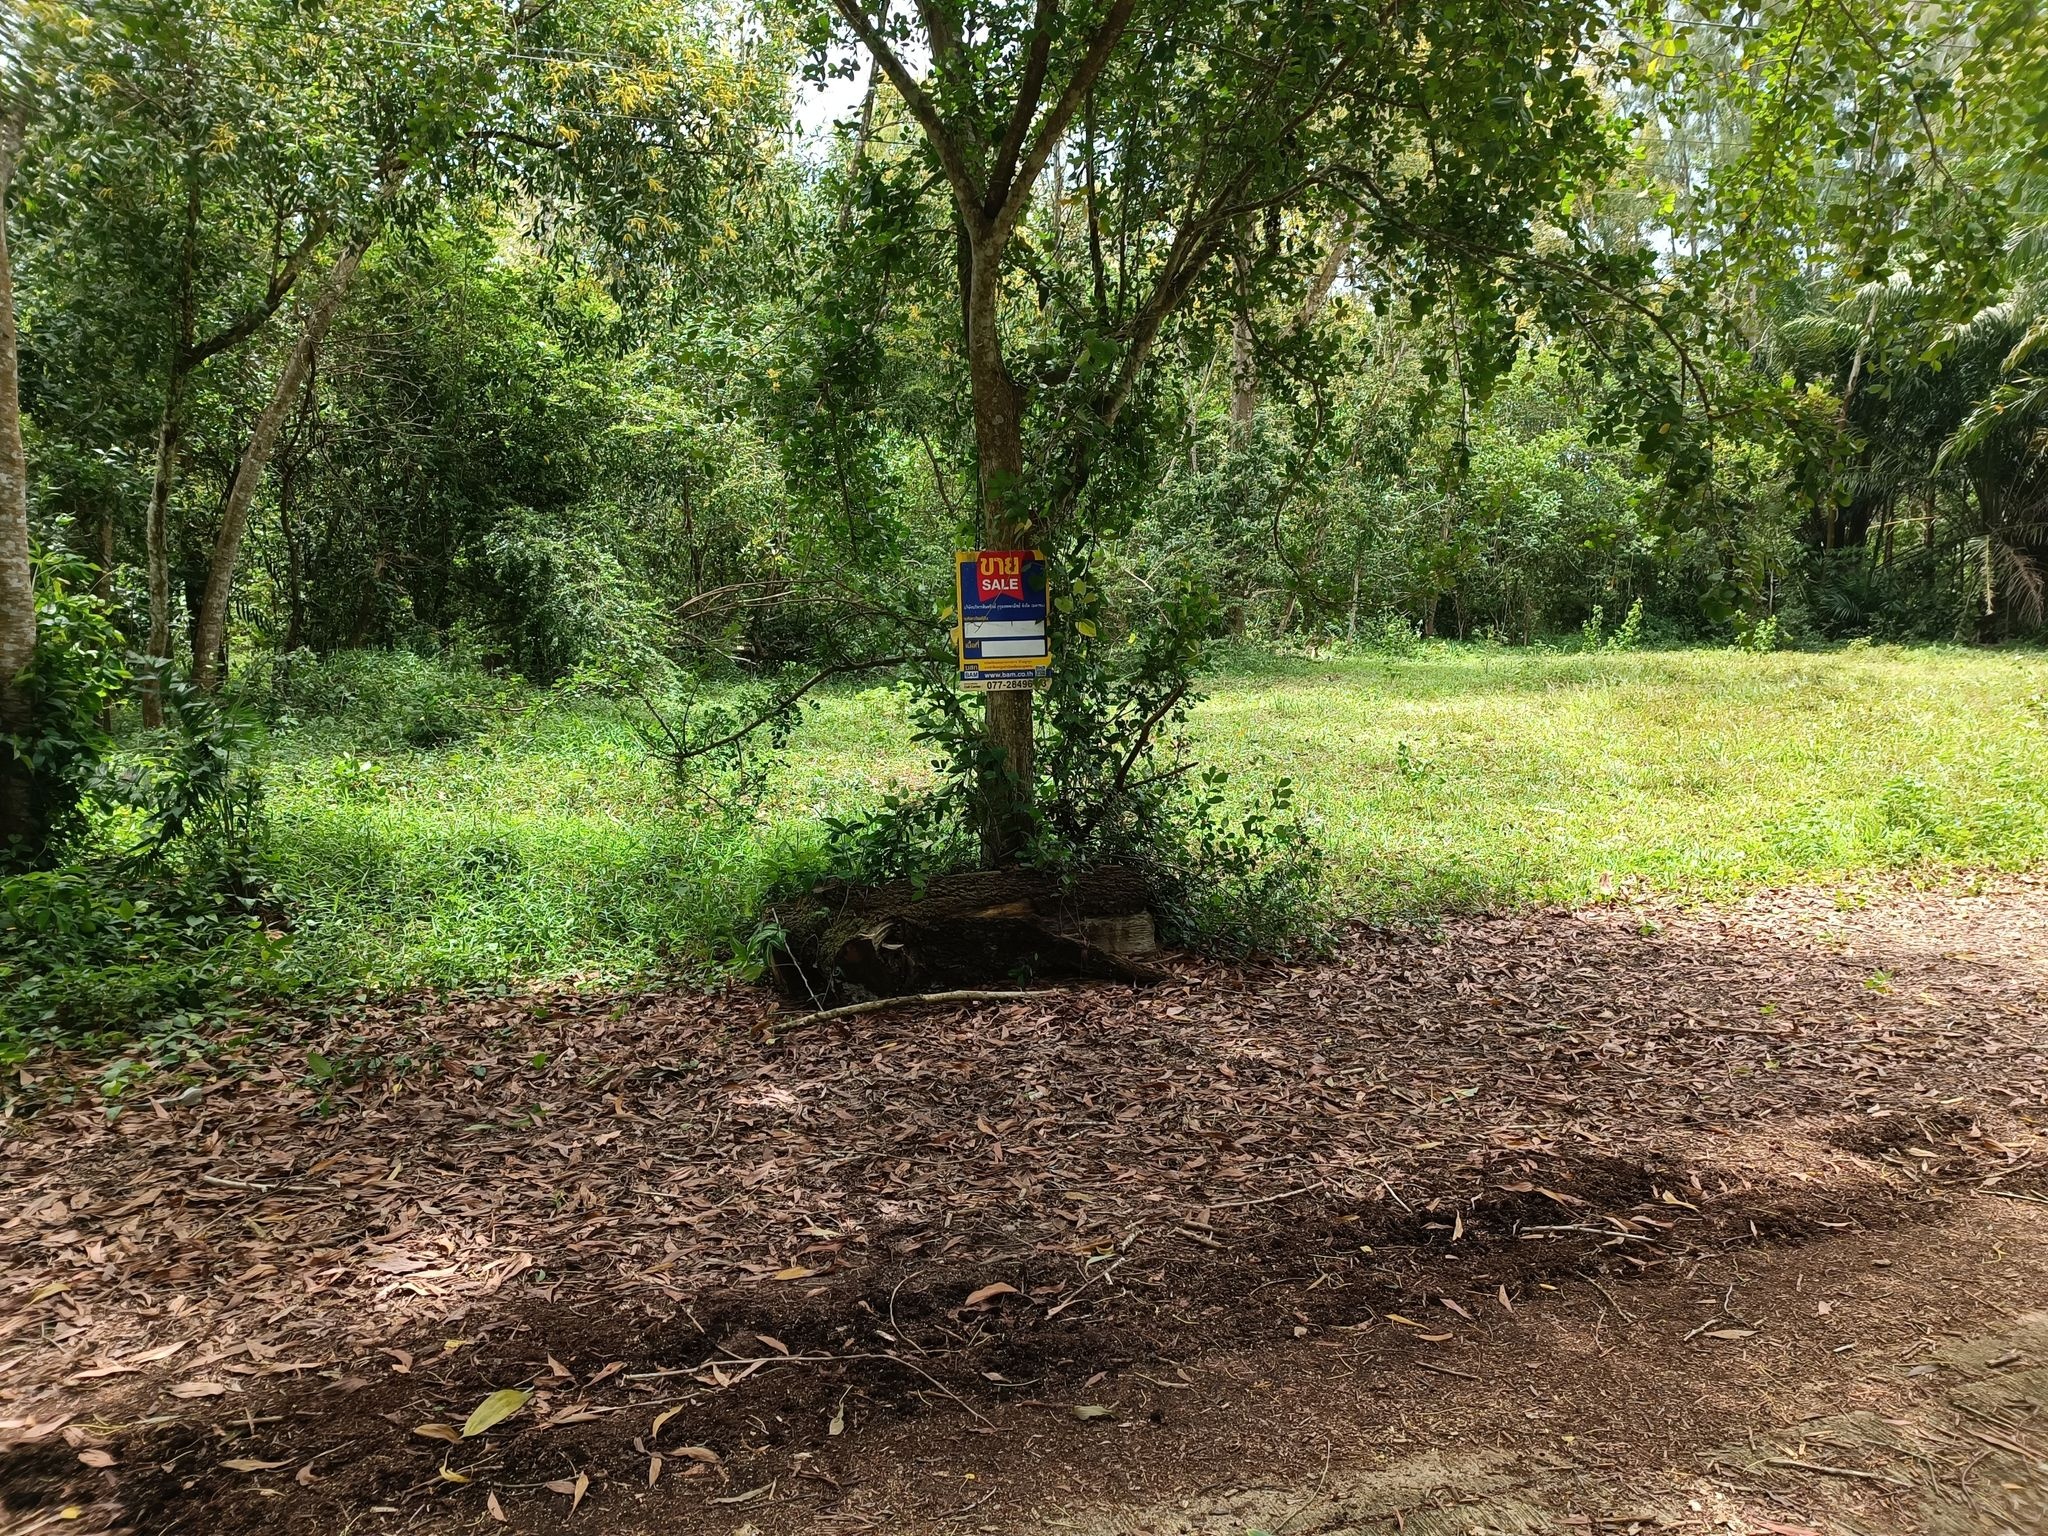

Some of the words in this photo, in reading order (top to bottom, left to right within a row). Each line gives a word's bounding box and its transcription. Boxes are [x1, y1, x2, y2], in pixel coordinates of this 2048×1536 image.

[980, 557, 1019, 575] ขาย
[982, 579, 1018, 590] SALE
[984, 671, 1034, 679] www.bam.co.th
